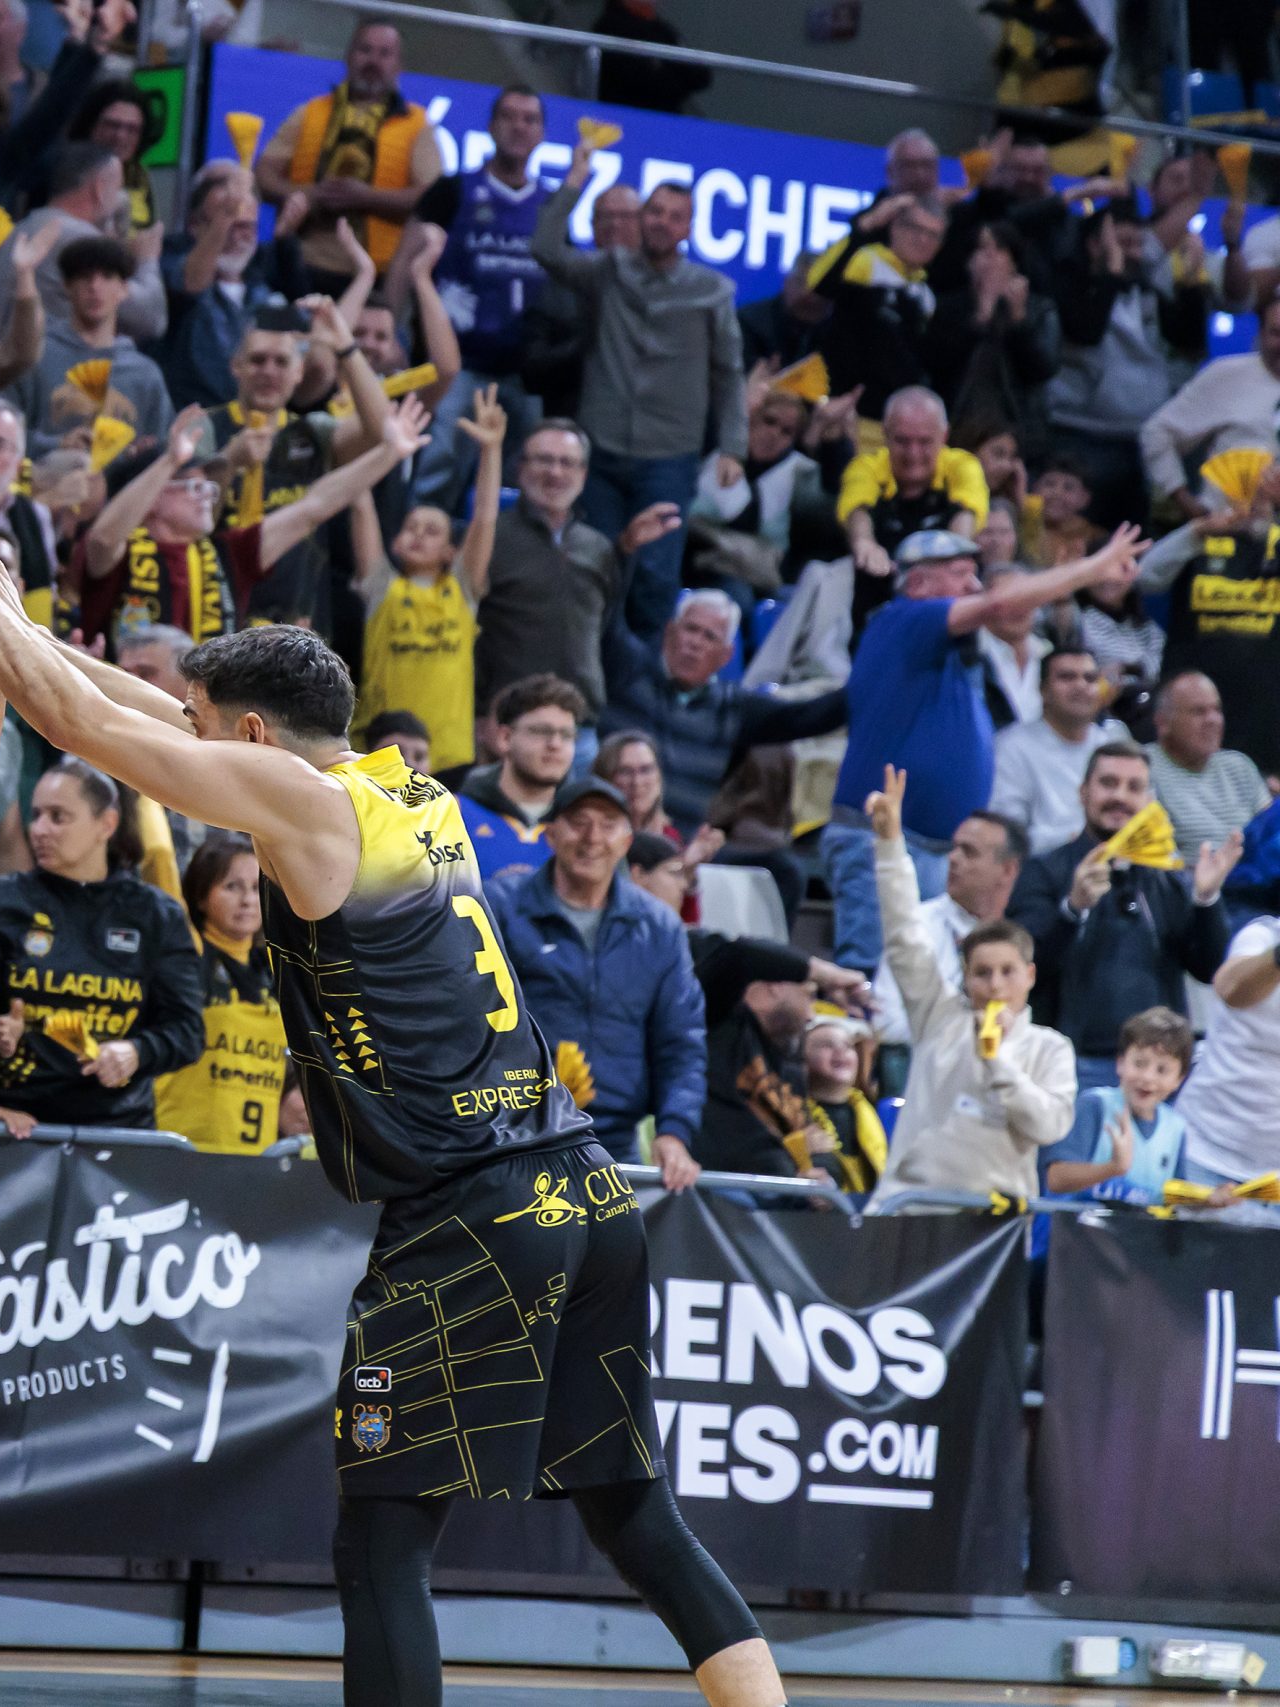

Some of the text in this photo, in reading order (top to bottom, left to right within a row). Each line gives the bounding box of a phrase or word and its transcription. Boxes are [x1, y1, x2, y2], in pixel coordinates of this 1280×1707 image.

[640, 158, 874, 272] CHE
[9, 964, 143, 1002] LA LAGUNA
[451, 895, 518, 1033] 3
[504, 1068, 540, 1081] IBERIA
[240, 1100, 263, 1144] 9
[595, 1202, 630, 1223] Canary
[2, 1353, 128, 1406] PRODUCTS
[358, 1376, 382, 1389] acb
